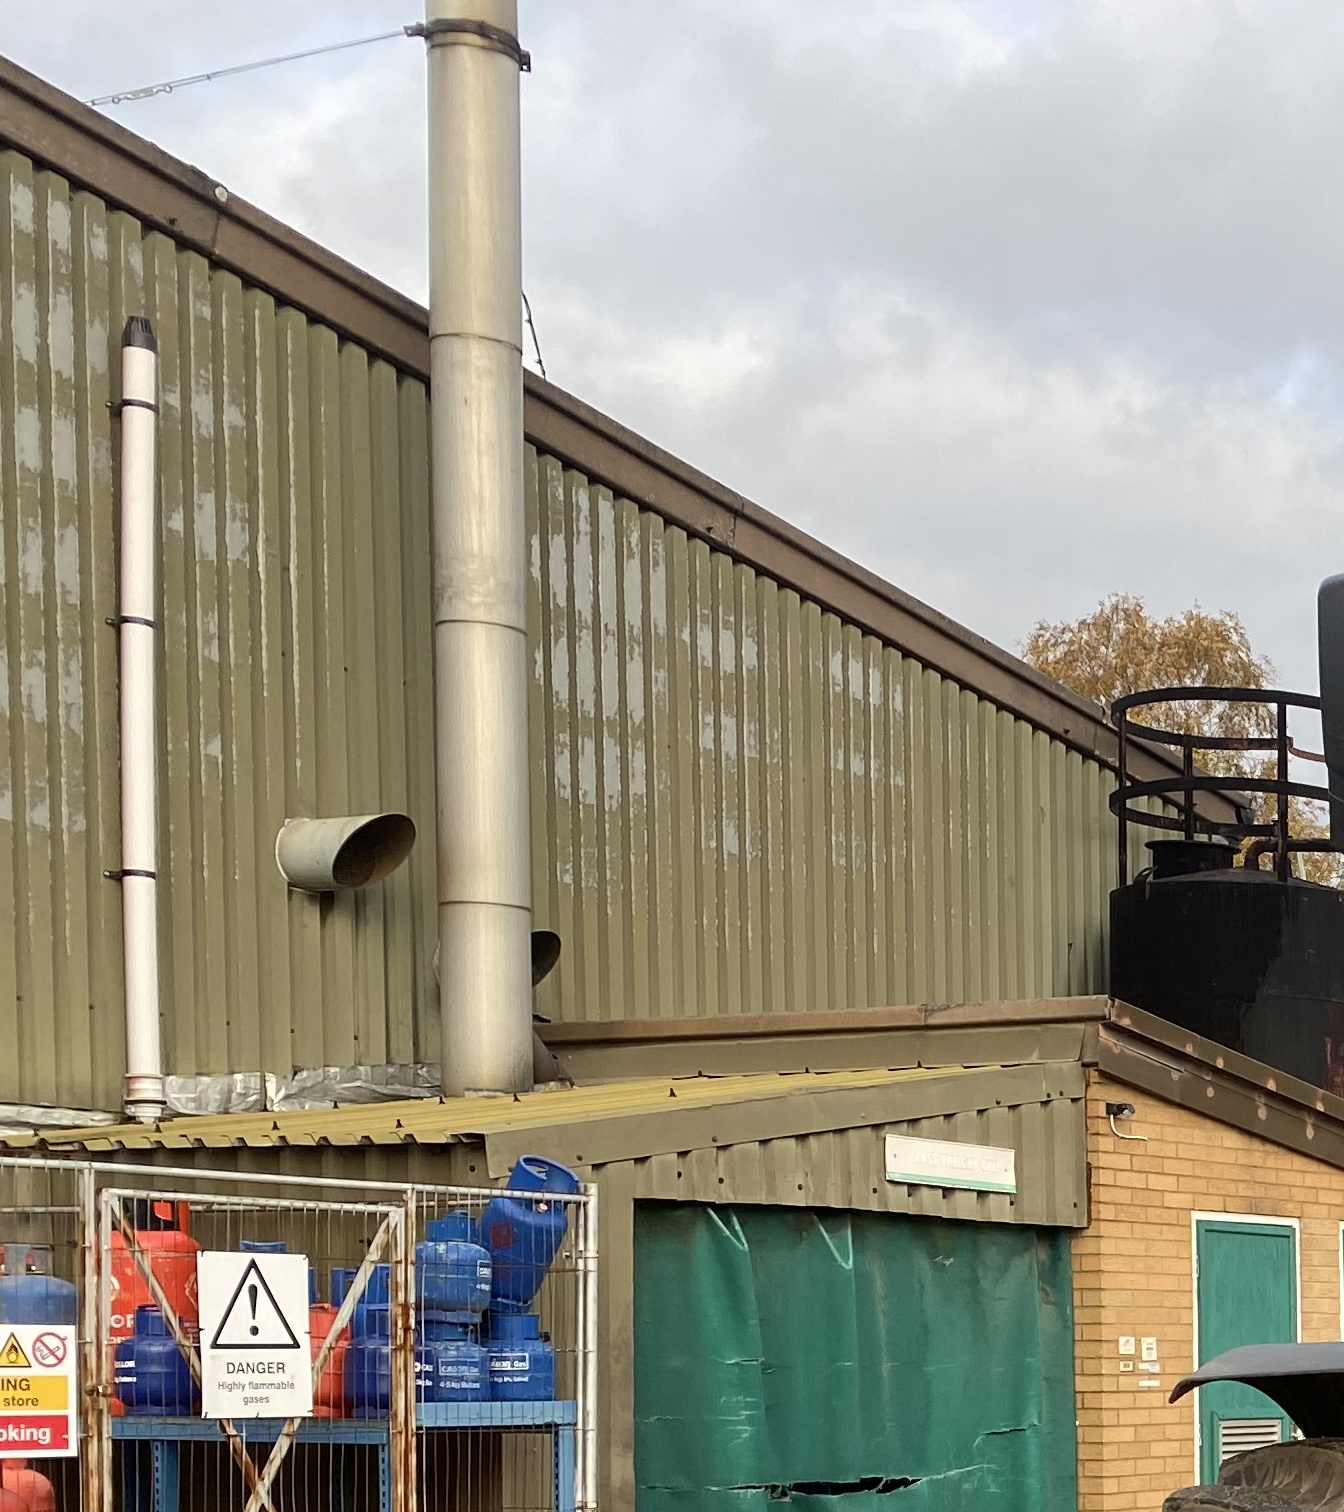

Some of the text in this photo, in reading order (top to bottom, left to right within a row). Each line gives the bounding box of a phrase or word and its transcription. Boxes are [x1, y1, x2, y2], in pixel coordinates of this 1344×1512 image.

[226, 1362, 286, 1374] DANGER
[218, 1381, 295, 1392] Highly flammable
[3, 1396, 39, 1407] store
[243, 1396, 270, 1405] gases
